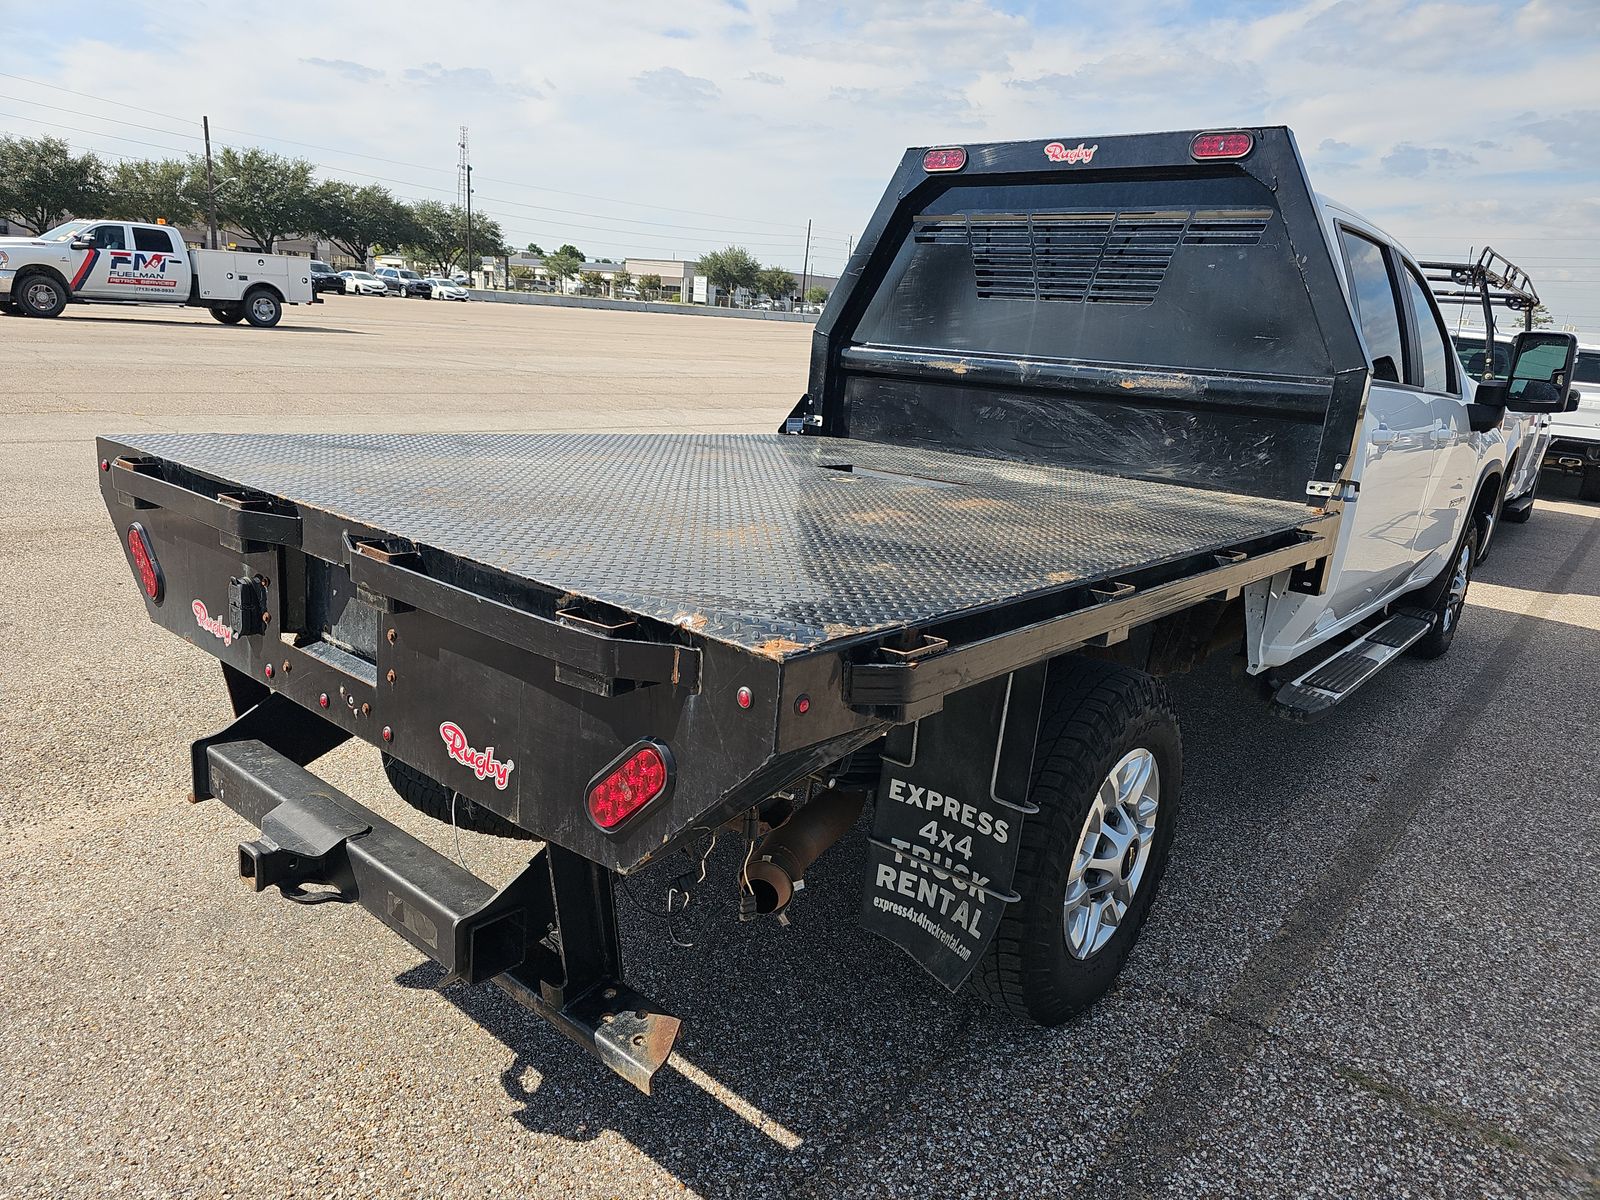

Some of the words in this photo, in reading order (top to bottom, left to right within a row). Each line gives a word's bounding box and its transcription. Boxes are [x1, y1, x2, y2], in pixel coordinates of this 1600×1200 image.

[1044, 142, 1095, 164] Rugby
[110, 271, 164, 279] FUELMAN
[192, 599, 232, 647] Rugby
[440, 721, 510, 790] Rugby
[888, 778, 1009, 844] EXPRESS
[918, 820, 972, 860] 4x4
[875, 863, 981, 939] RENTAL
[891, 837, 990, 904] TRUCK
[873, 896, 972, 961] express4x4truckrental.com
